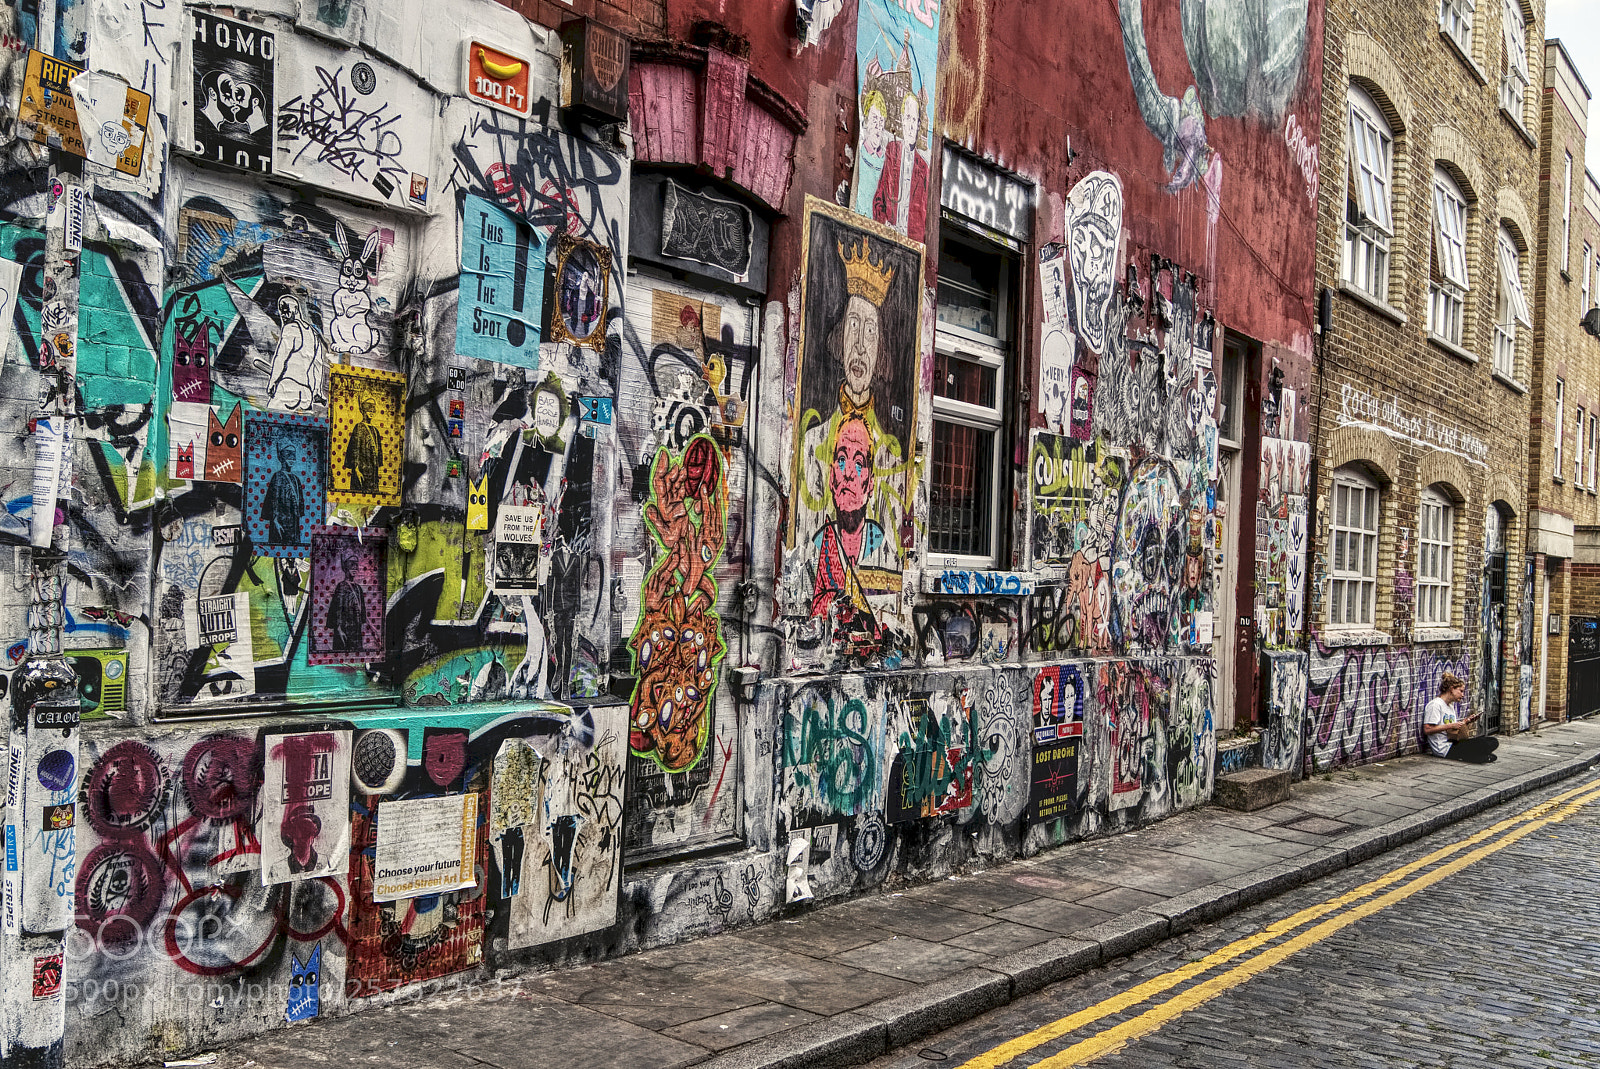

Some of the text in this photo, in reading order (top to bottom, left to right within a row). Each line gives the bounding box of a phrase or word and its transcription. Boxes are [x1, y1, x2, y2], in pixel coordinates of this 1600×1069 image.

[192, 16, 274, 60] HOMO
[475, 75, 502, 99] 100
[36, 110, 78, 130] STREET
[72, 188, 83, 248] SHRINE
[449, 368, 458, 379] GO
[1049, 366, 1065, 383] VERY
[456, 379, 465, 390] DO
[538, 395, 555, 408] BAR
[504, 514, 533, 523] SAVE US
[503, 523, 520, 532] FROM
[503, 533, 533, 543] WOLVES
[199, 596, 235, 615] STRAIGHT
[200, 632, 238, 645] EUROPE
[1035, 750, 1052, 764] LOST
[7, 745, 20, 807] SHRINE
[378, 859, 461, 879] Choose your future
[376, 873, 458, 896] Choose Street Art
